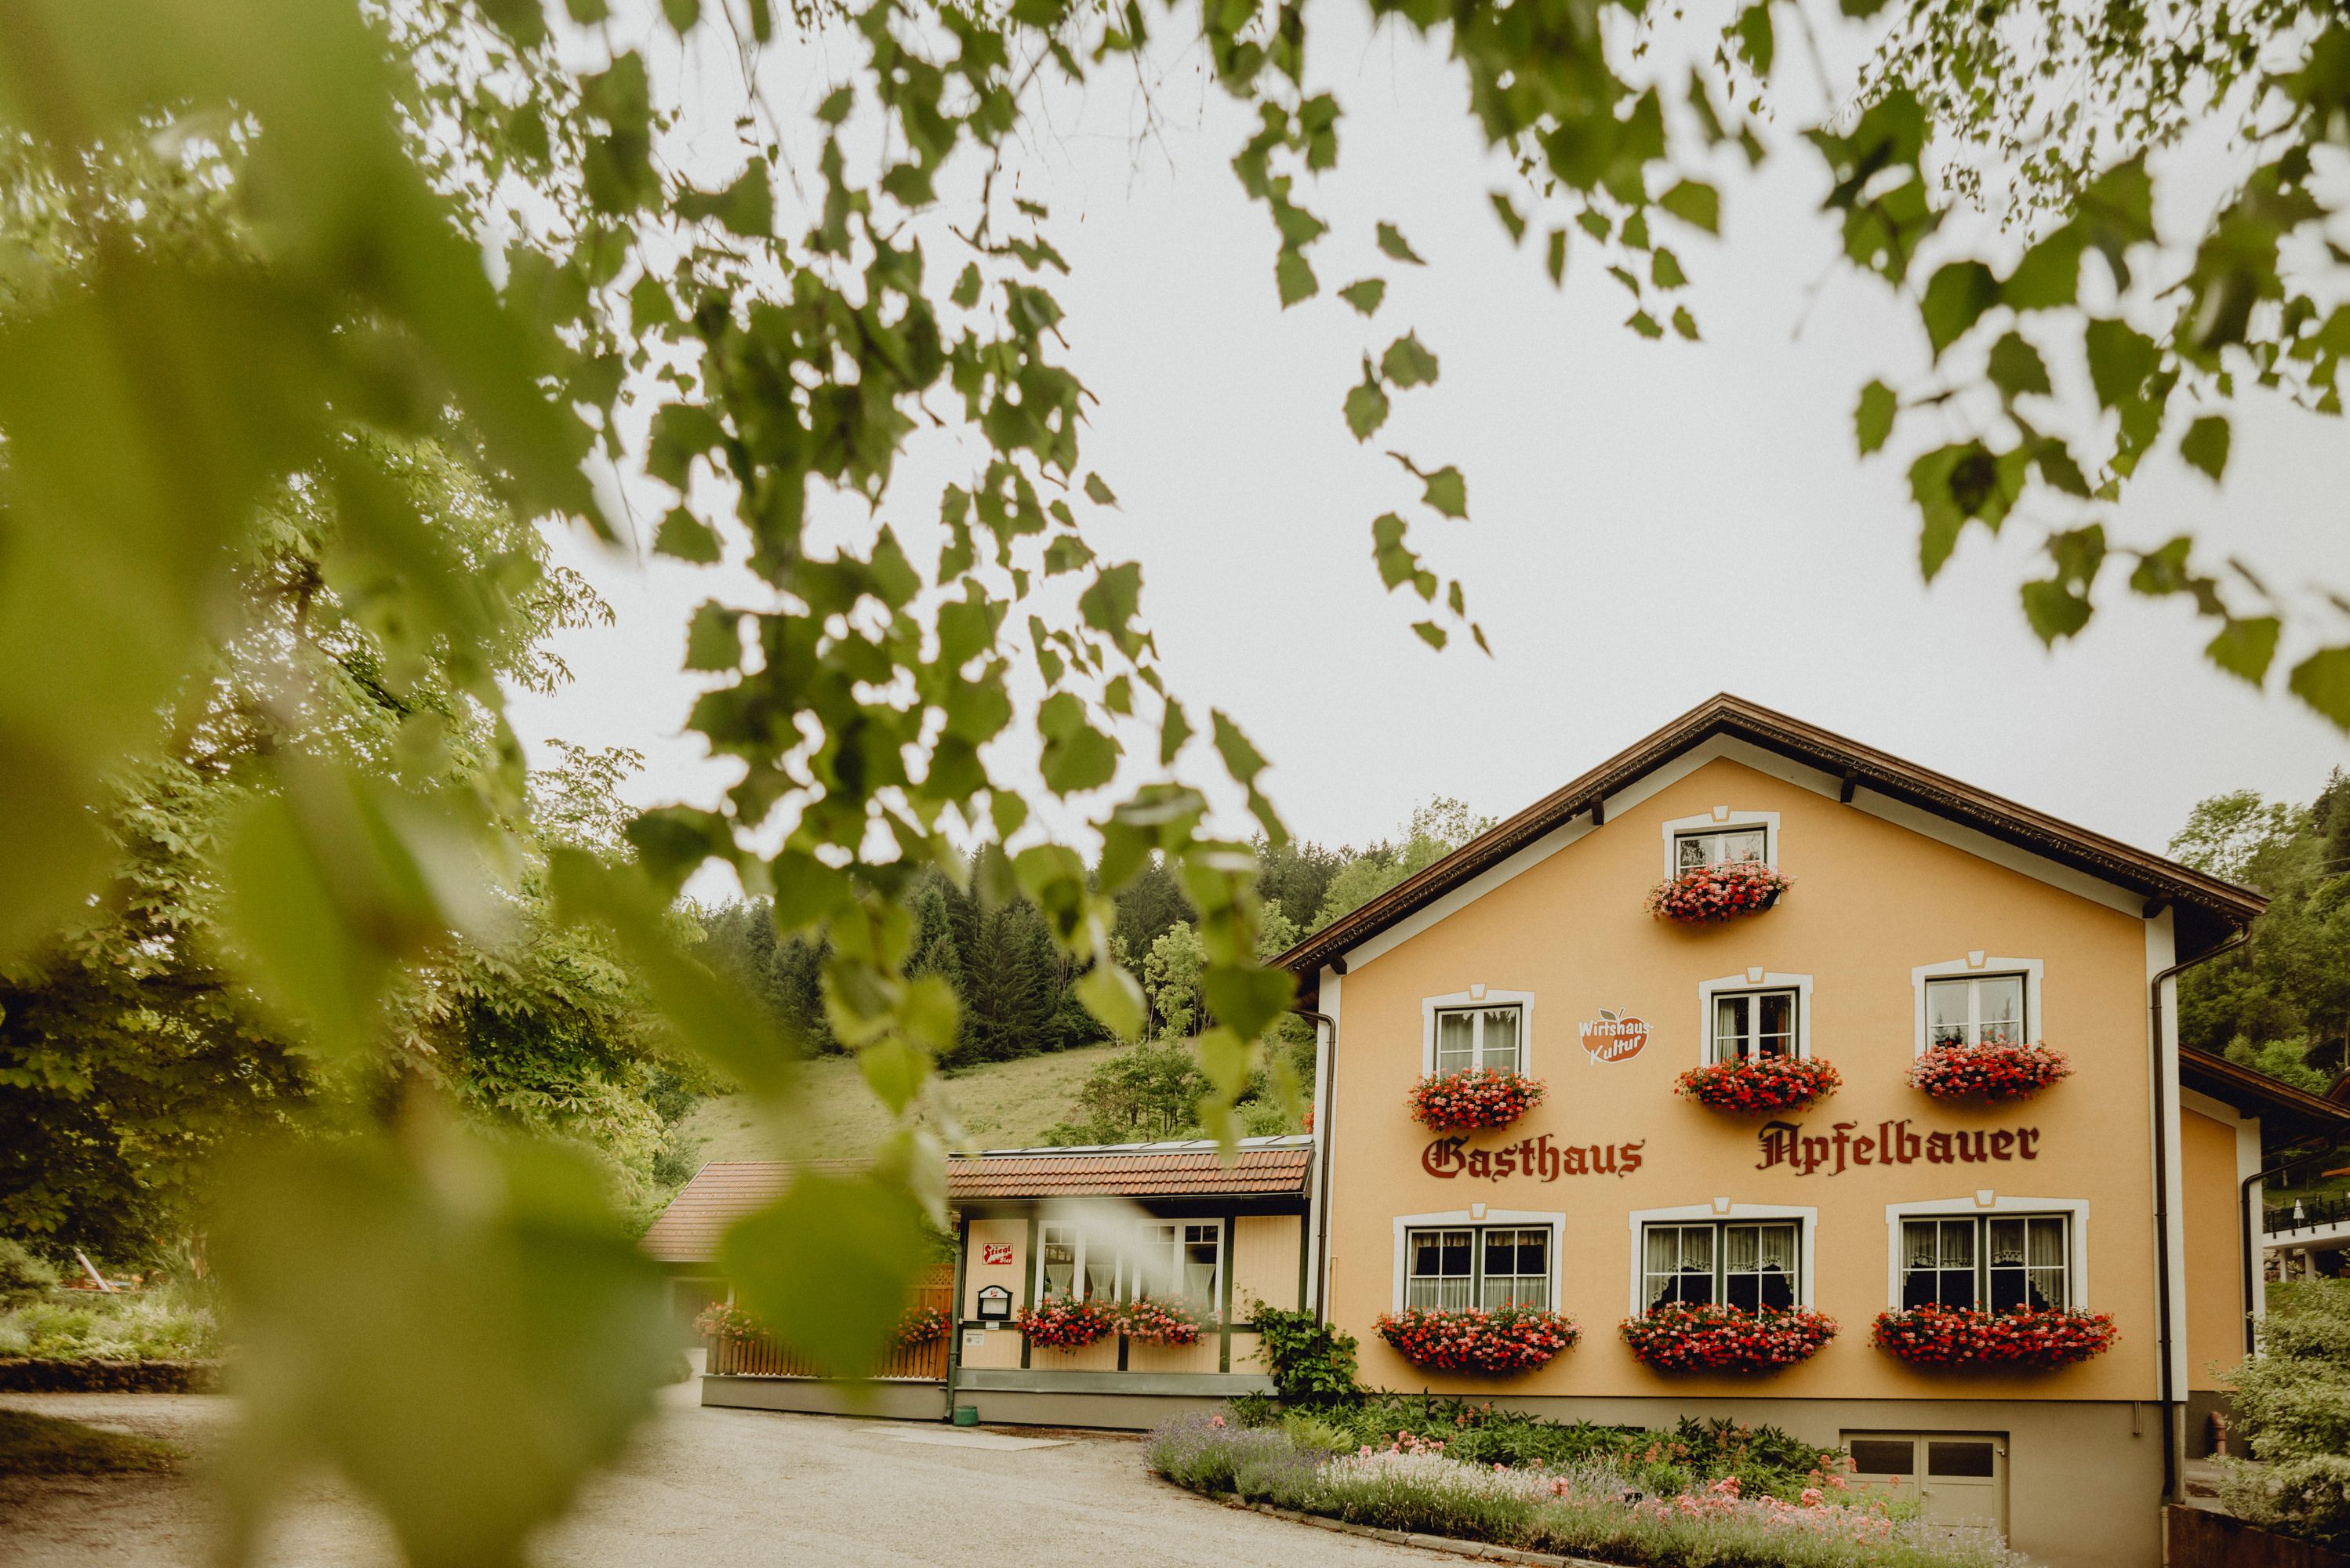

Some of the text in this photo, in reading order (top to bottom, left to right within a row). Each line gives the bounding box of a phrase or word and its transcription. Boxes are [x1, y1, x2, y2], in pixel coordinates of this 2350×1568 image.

[1590, 1035, 1642, 1065] Kultur
[1422, 1119, 2039, 1183] Gasthaus Apfelbauer
[984, 1244, 1011, 1262] Stiegl
